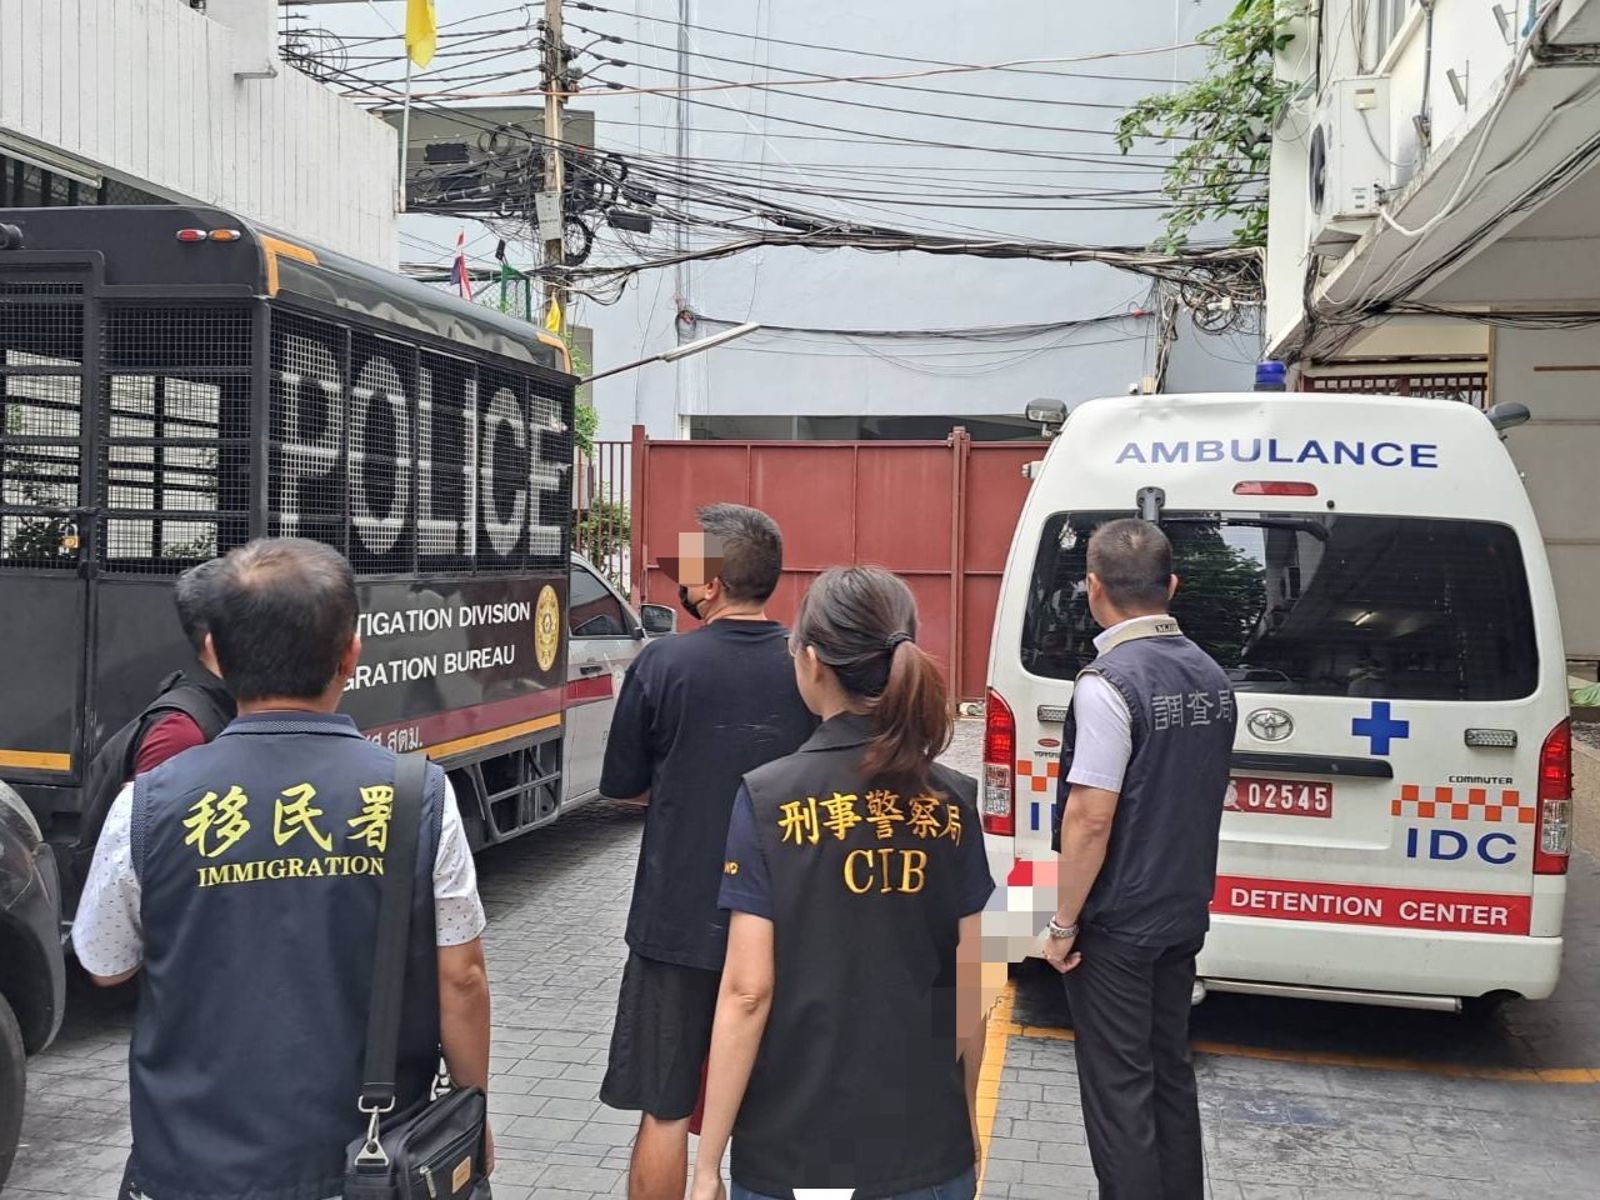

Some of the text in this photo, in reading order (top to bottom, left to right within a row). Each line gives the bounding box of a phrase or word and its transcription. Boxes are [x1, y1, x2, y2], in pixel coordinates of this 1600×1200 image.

[280, 333, 563, 556] POLICE
[1115, 438, 1438, 468] AMBULANCE
[459, 602, 531, 627] DIVISION
[444, 644, 515, 675] BUREAU
[1152, 689, 1234, 731] 調查局
[1249, 783, 1328, 811] 02545
[1448, 775, 1513, 785] COMMUTER
[182, 783, 394, 857] 移民署
[778, 789, 962, 847] 刑事警察局
[1406, 828, 1517, 865] IDC
[197, 856, 384, 887] IMMIGRATION
[843, 848, 927, 894] CIB
[1231, 888, 1509, 926] DETENTION CENTER
